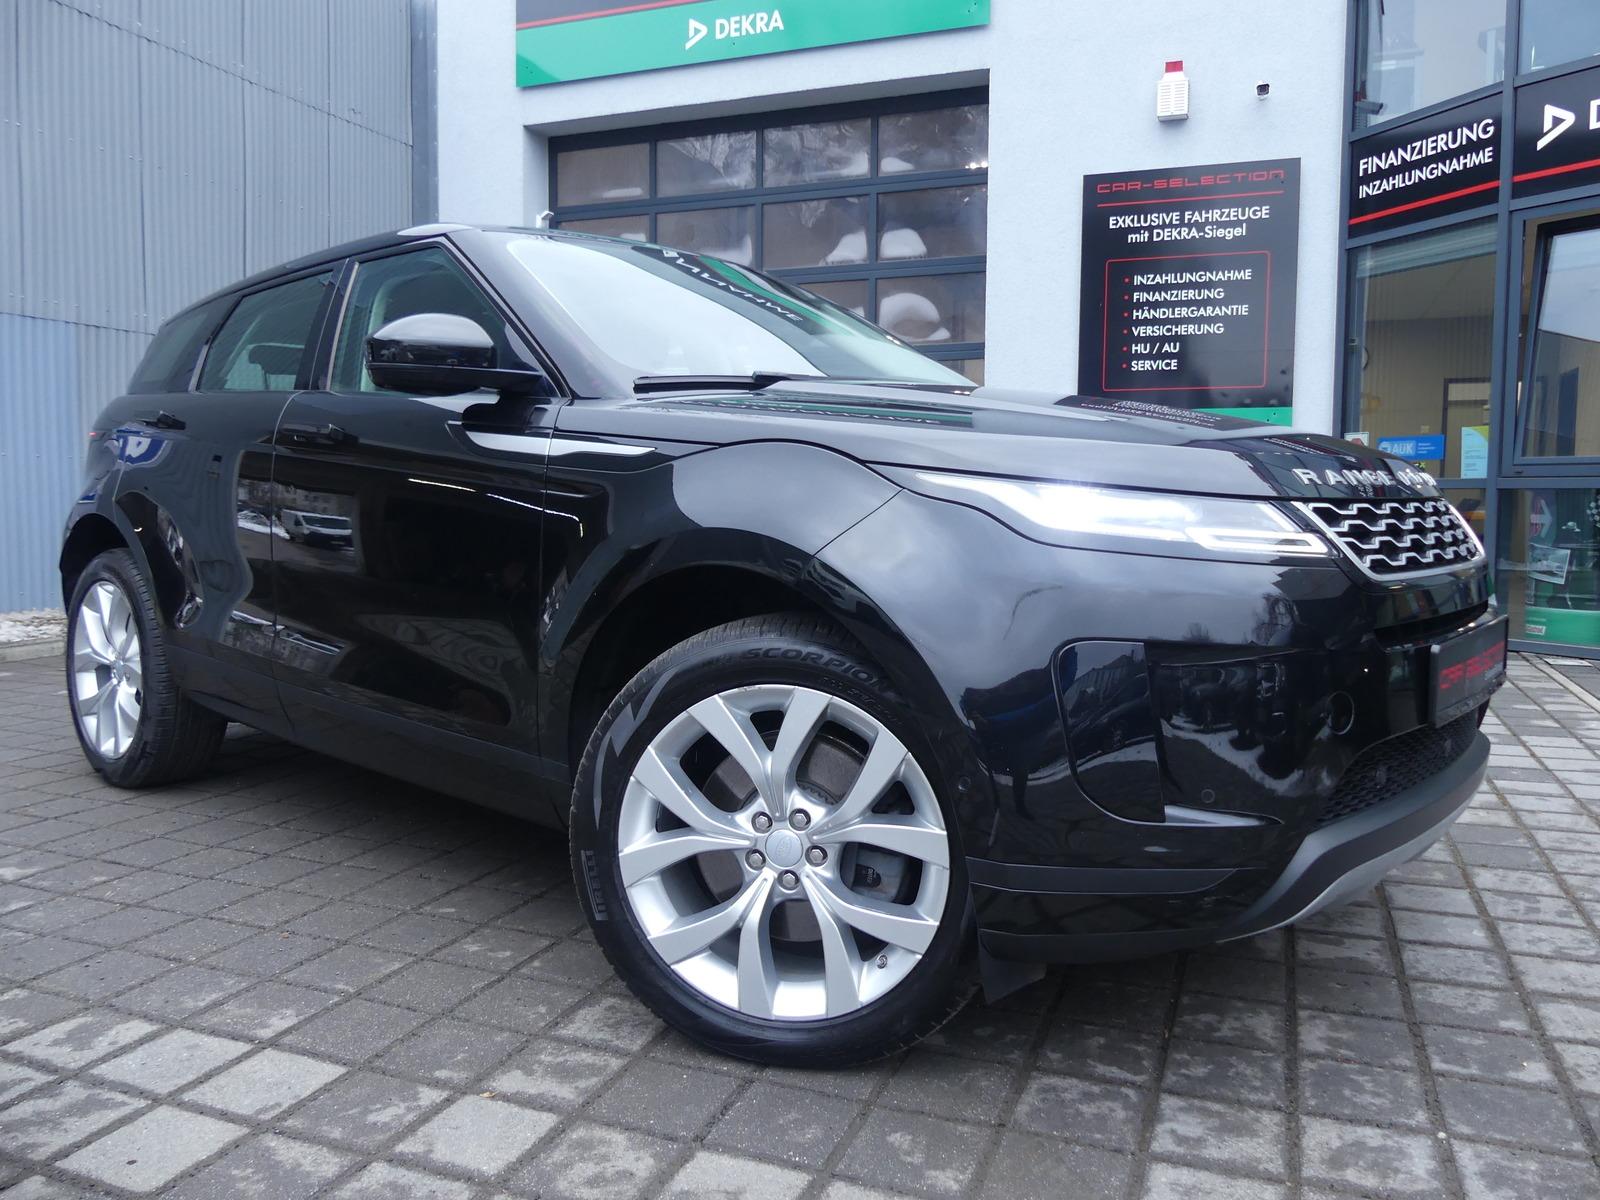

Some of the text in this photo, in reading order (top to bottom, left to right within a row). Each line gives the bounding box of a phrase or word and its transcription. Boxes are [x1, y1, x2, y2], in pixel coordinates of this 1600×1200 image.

[715, 9, 784, 40] DEKRA
[1359, 118, 1495, 177] FINANZIERUNG
[1359, 147, 1494, 199] INZAHLUNGNAHME
[1109, 205, 1271, 229] EXKLUSIVE FAHRZEUGE
[1128, 223, 1247, 244] mit DEKRA-Siegel
[1133, 269, 1252, 286] INZAHLUNGNAHME
[1132, 288, 1225, 303] FINANZIERUNG
[1132, 304, 1249, 320] HÄNDLERGARANTIE
[1132, 323, 1225, 337] VERSICHERUNG
[1132, 343, 1150, 355] HU
[1161, 342, 1180, 353] AU
[1131, 359, 1178, 371] SERVICE
